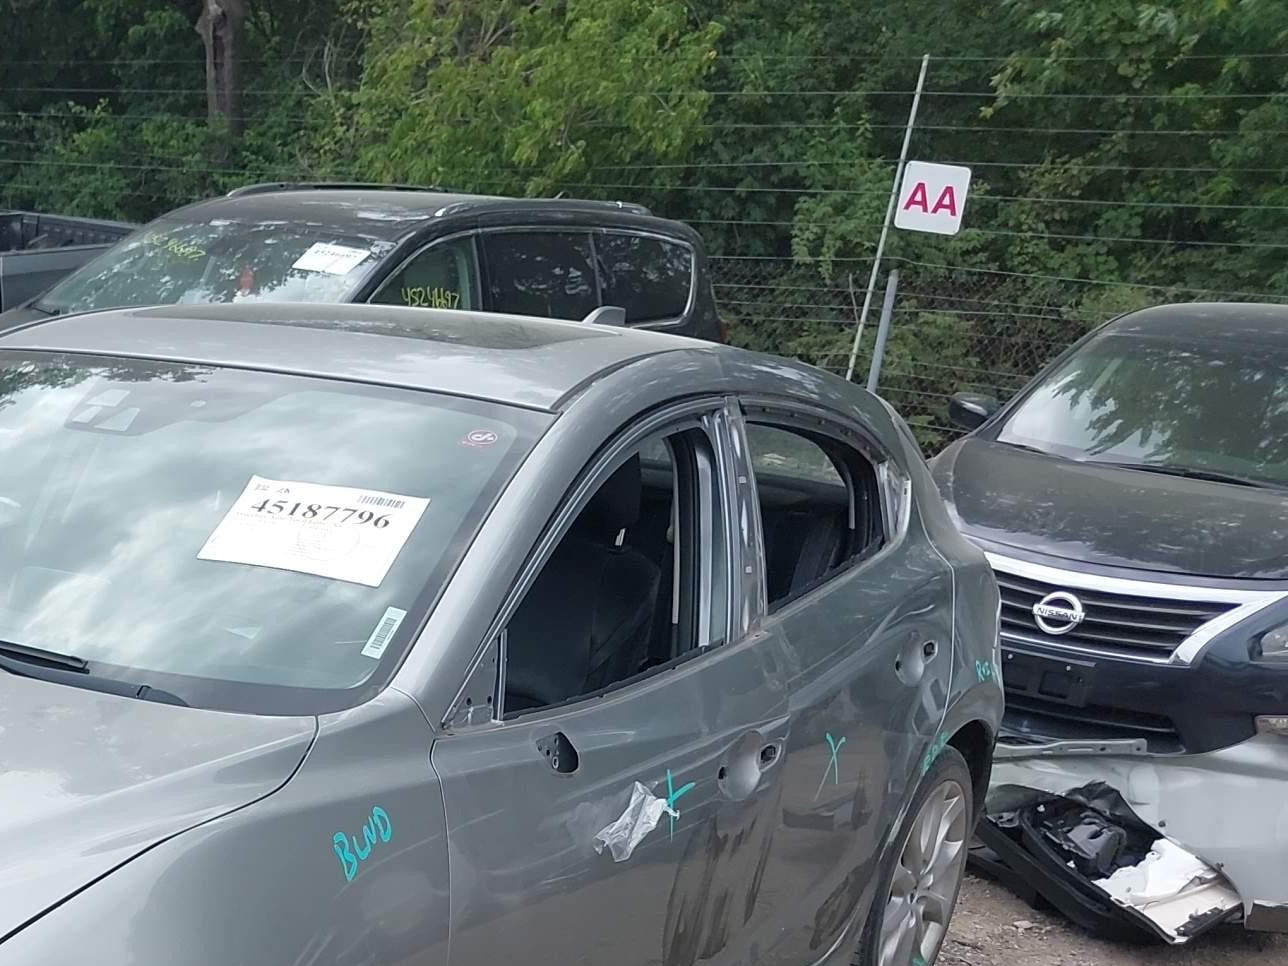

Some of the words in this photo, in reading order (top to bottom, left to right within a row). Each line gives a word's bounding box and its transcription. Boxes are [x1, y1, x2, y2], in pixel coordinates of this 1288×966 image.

[903, 182, 956, 217] AA
[251, 498, 392, 529] 45187796
[1036, 607, 1078, 621] NISSAN
